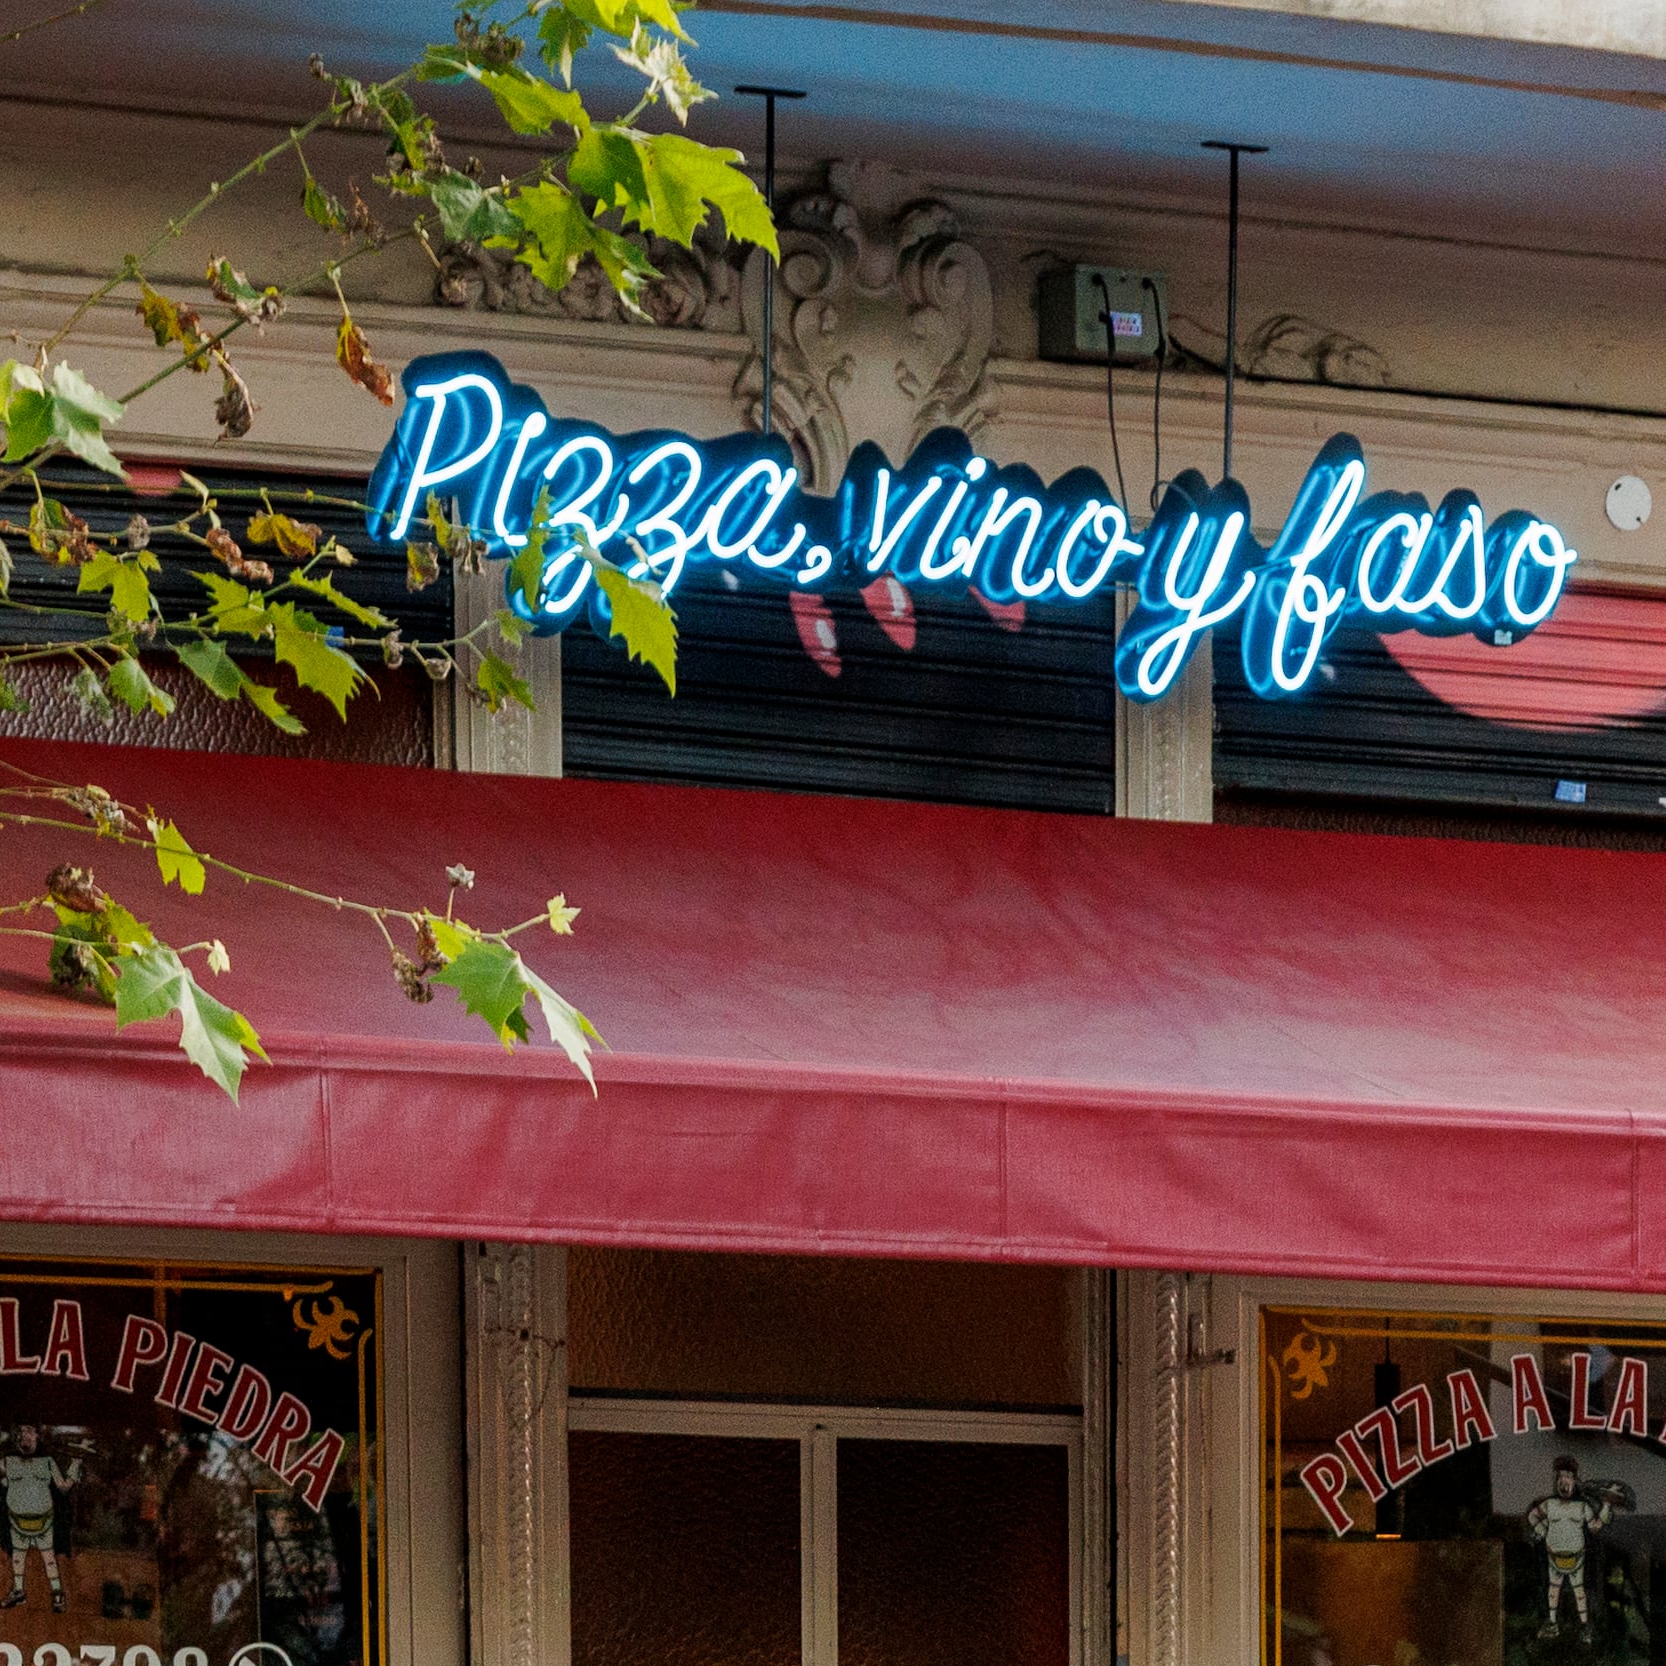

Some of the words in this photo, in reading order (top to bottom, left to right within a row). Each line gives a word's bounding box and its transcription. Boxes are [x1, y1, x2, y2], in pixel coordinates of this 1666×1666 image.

[390, 373, 833, 616] Pizza,
[867, 456, 1145, 599] vino
[1136, 510, 1256, 697] y
[1270, 458, 1579, 692] faso
[111, 1313, 345, 1512] PIEDRA
[1300, 1369, 1497, 1538] PIZZA
[1512, 1353, 1555, 1433] A
[1568, 1352, 1649, 1437] LA
